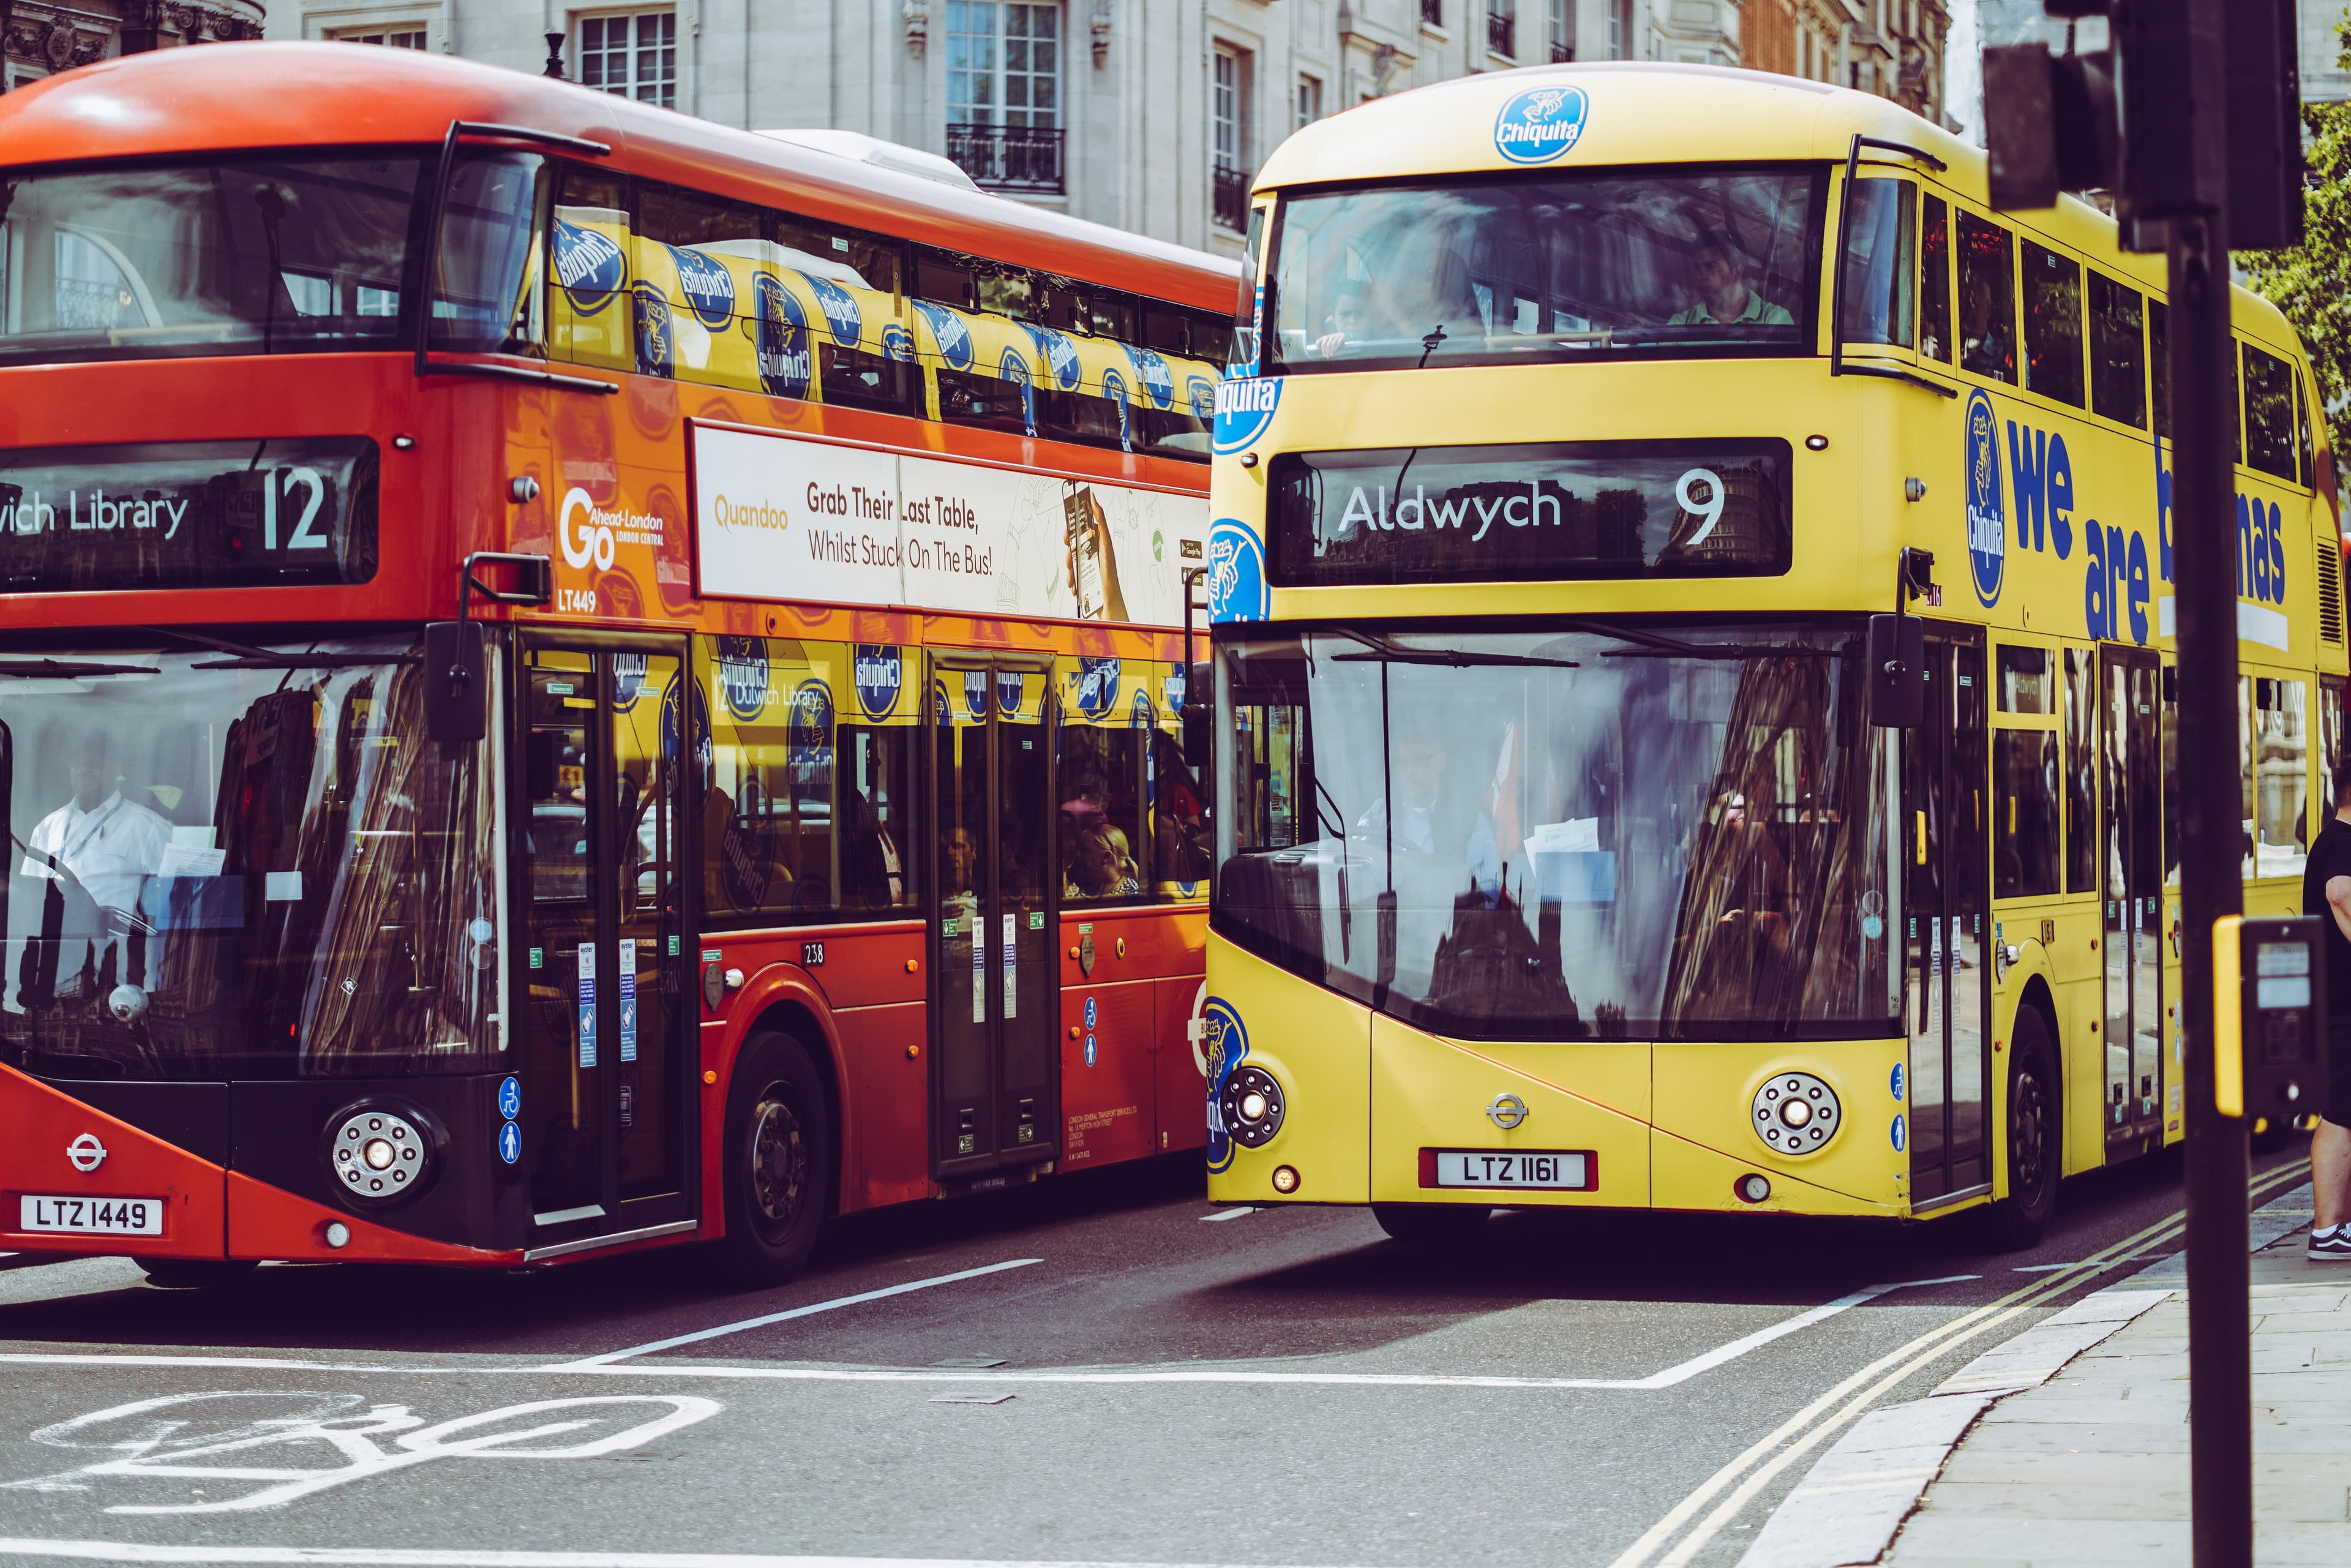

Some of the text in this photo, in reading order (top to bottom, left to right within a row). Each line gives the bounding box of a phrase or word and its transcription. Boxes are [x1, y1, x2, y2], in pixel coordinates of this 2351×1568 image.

[1496, 120, 1578, 147] Chiquita
[2007, 419, 2074, 560] we
[70, 489, 189, 539] Library
[264, 467, 328, 550] 12
[715, 493, 788, 533] Quandoo
[807, 481, 978, 535] Grab Their Last Table,
[1338, 468, 1725, 546] Aldwych 9
[616, 530, 664, 546] LONDON CENTRAL
[808, 528, 992, 576] Whilst Stuck On The Bus!
[1967, 504, 2004, 568] Chiquita
[2085, 519, 2150, 645] are
[558, 588, 596, 612] LT449
[714, 674, 819, 712] 12 Dulwich Library
[621, 942, 633, 950] oyster
[805, 943, 823, 964] 238
[1068, 1115, 1083, 1124] LONDON
[1068, 1131, 1083, 1140] LONDON
[1464, 1157, 1558, 1182] LTZ 1161
[37, 1199, 146, 1229] LTZ 1449
